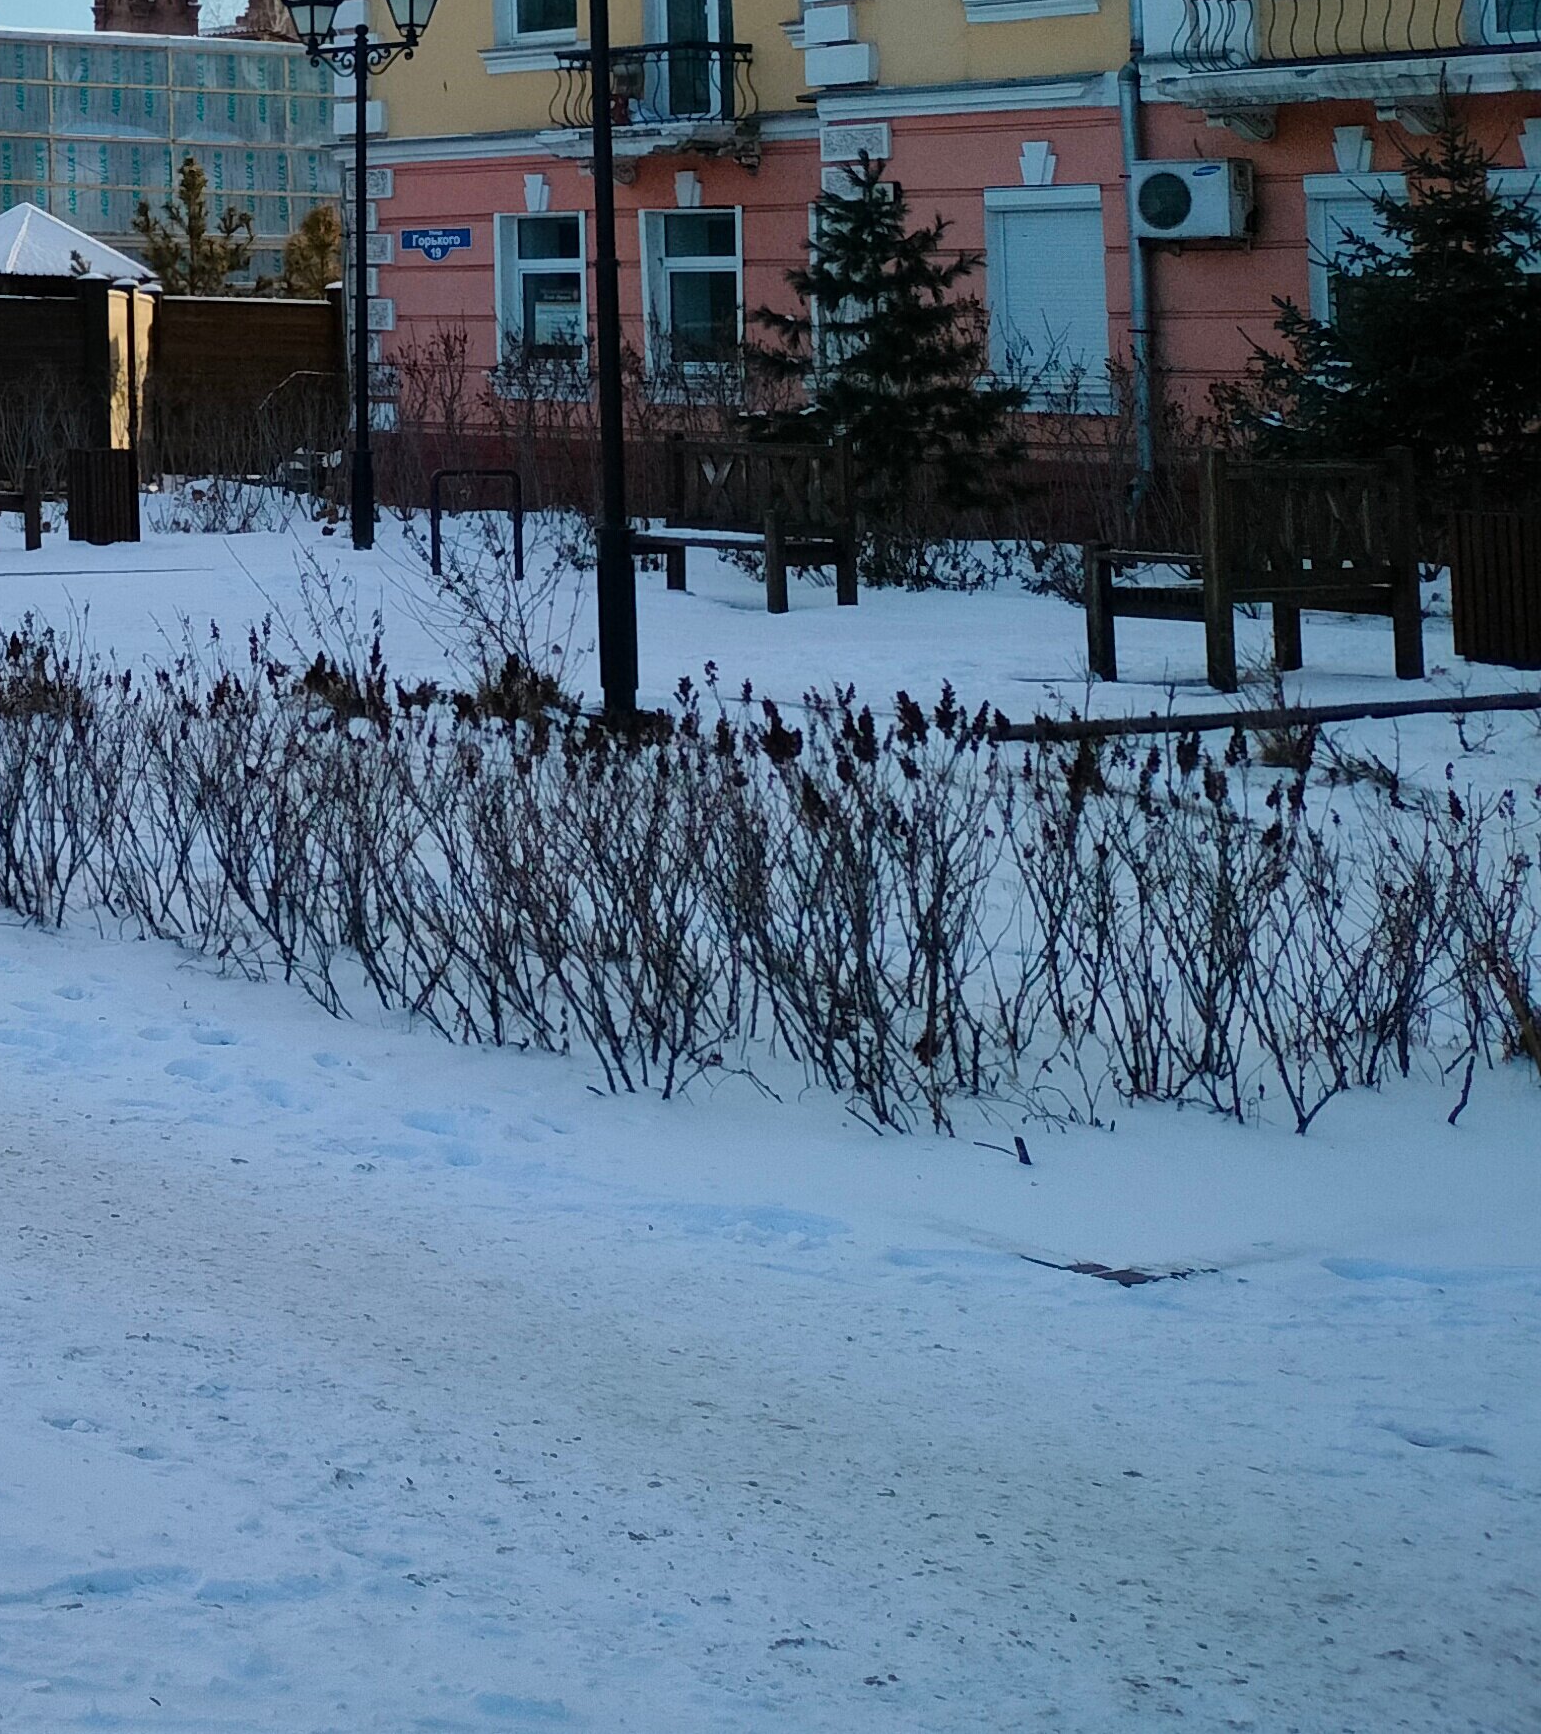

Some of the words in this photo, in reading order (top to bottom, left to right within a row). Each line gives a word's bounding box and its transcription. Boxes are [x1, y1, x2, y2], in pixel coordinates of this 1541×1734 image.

[111, 58, 121, 117] AGRLUX
[144, 60, 153, 118] AGRLUX
[412, 234, 461, 249] Горького
[430, 247, 441, 258] 19
